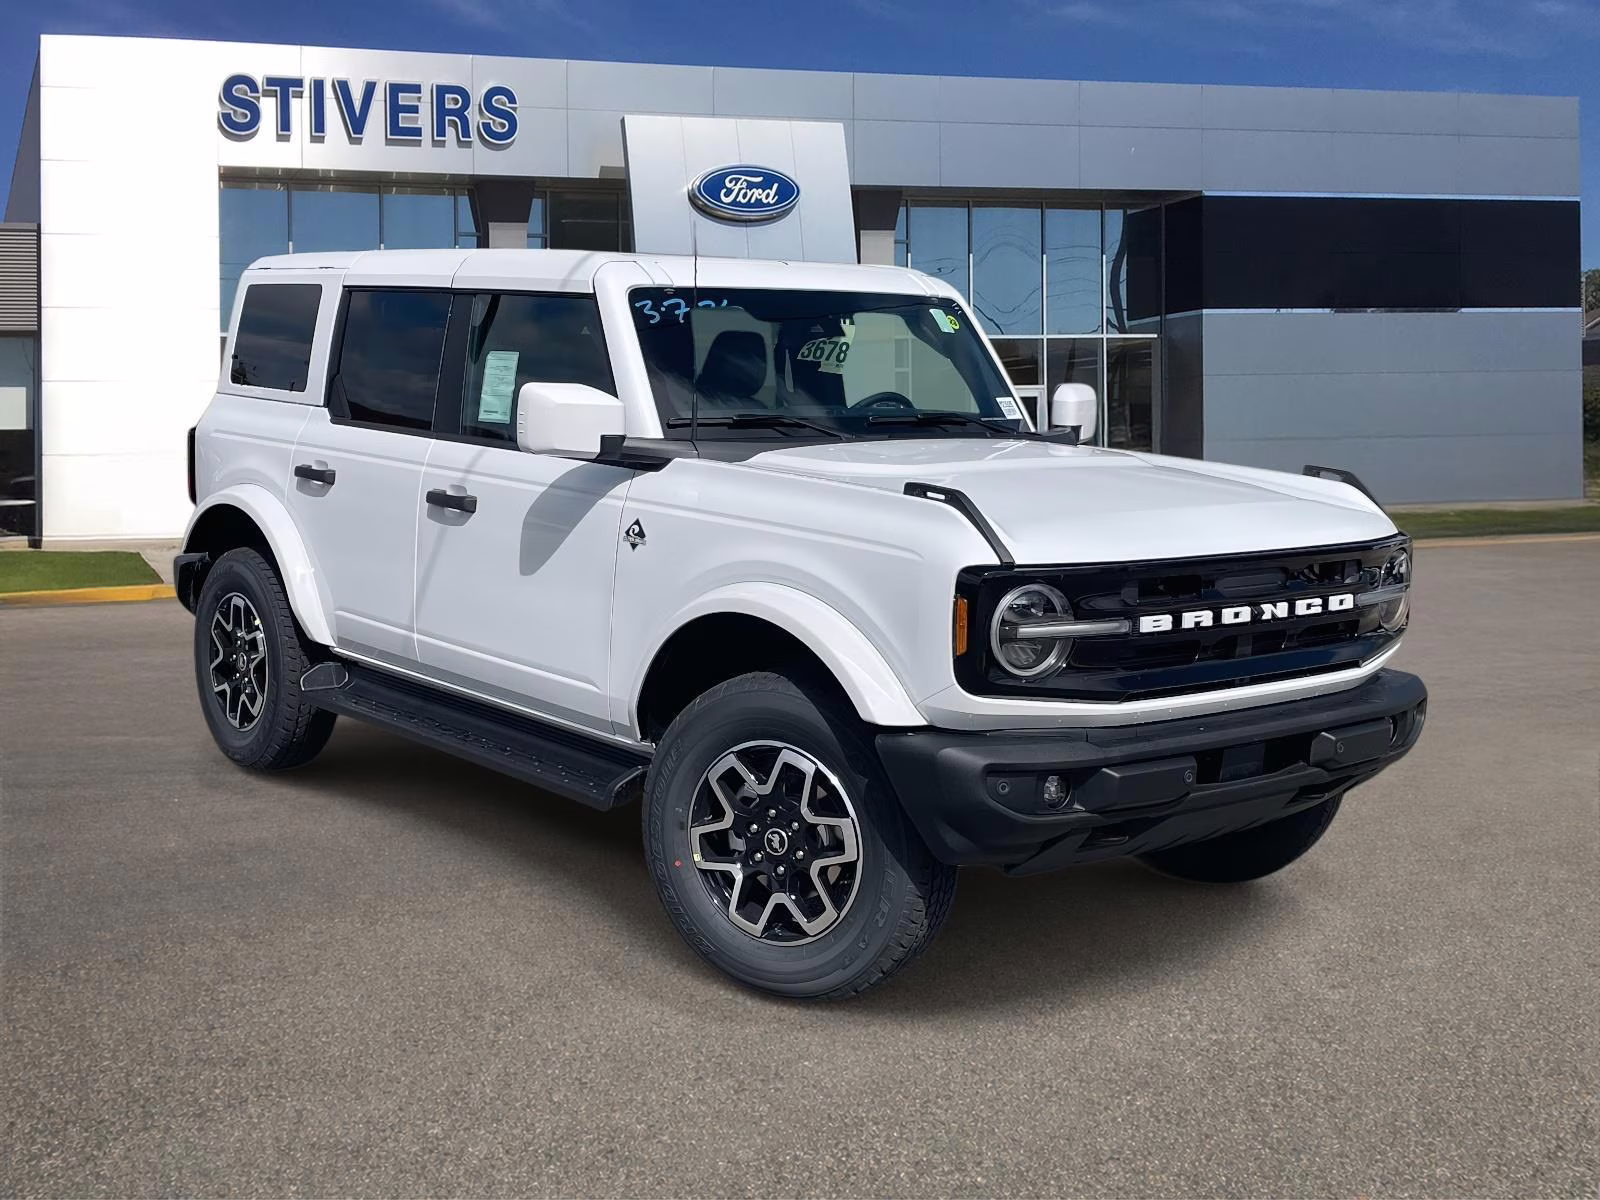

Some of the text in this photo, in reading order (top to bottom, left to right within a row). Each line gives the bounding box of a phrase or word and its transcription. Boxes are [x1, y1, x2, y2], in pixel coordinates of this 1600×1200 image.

[218, 72, 519, 147] STIVERS
[720, 174, 778, 204] Ford
[800, 339, 850, 364] 3678
[1139, 593, 1354, 633] BRONCO
